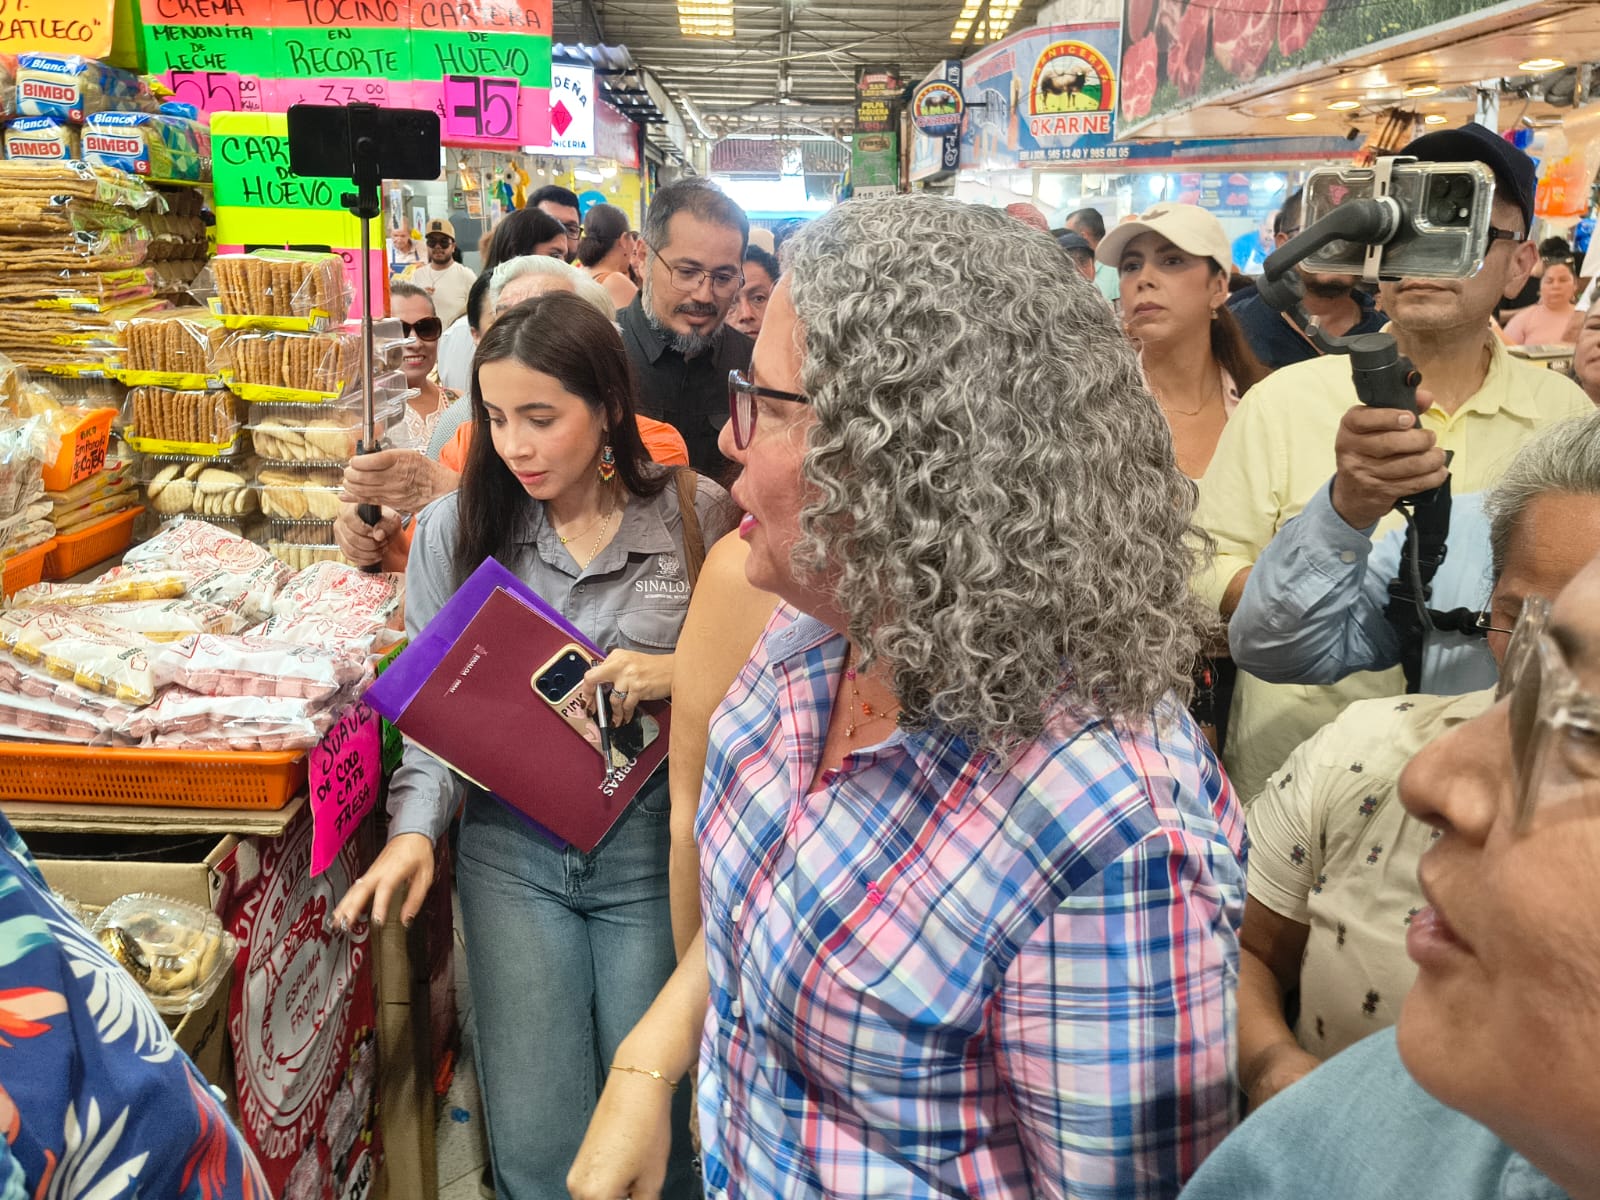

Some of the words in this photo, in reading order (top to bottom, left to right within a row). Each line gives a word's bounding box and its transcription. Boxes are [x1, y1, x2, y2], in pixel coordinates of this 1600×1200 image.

[157, 0, 245, 18] CREMA
[286, 0, 398, 25] TOCINO
[328, 27, 352, 40] EN
[467, 31, 489, 43] DE
[190, 42, 206, 52] DE
[285, 40, 398, 75] RECORTE
[32, 58, 70, 73] Blanco
[165, 51, 228, 71] LECHE
[435, 43, 529, 76] HUEVO
[23, 83, 75, 101] BIMBO
[14, 118, 50, 130] Blanco
[94, 113, 131, 124] Blanco
[1030, 115, 1110, 136] QKARNE
[10, 142, 61, 156] BIMBO
[87, 137, 138, 153] BIMBO
[221, 136, 293, 165] CAR
[243, 176, 333, 207] HUEVO
[322, 700, 373, 775] SUAVES
[603, 757, 638, 797] OBRAS
[317, 778, 332, 802] DE
[334, 782, 371, 838] FRESA
[286, 950, 321, 1012] ESPUMA
[290, 983, 320, 1035] FROTH
[231, 1012, 298, 1159] DISTRIBUIDOR
